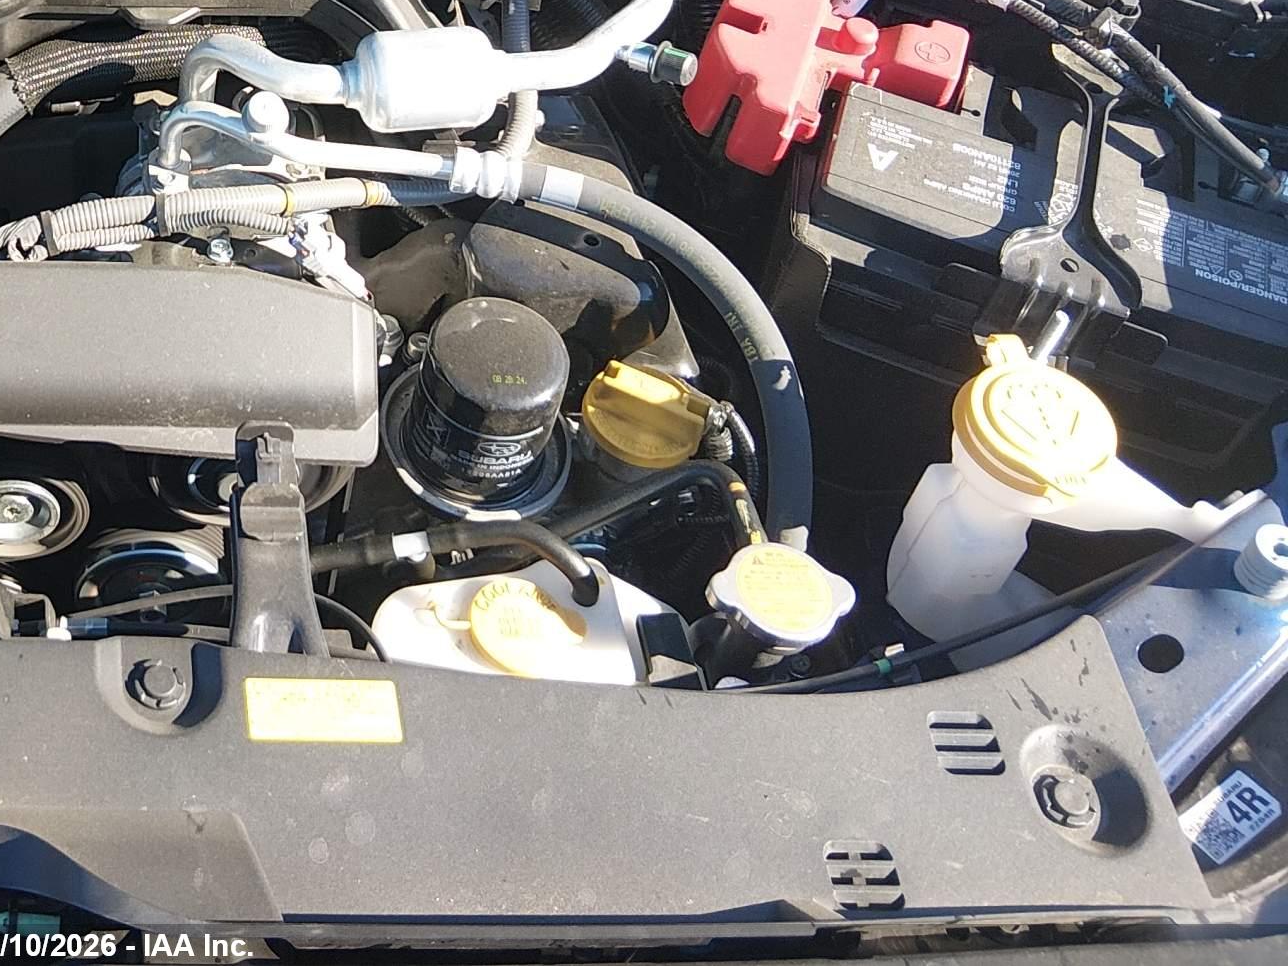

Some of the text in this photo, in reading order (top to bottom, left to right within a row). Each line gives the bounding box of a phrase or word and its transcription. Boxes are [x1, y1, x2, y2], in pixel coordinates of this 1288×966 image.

[867, 143, 899, 171] A
[961, 182, 996, 199] AMPS
[987, 182, 1018, 196] GROUP
[991, 199, 1016, 213] COLD
[1194, 268, 1288, 305] DANGER/POISON
[457, 449, 532, 465] SUBARU
[1226, 786, 1271, 824] 4R
